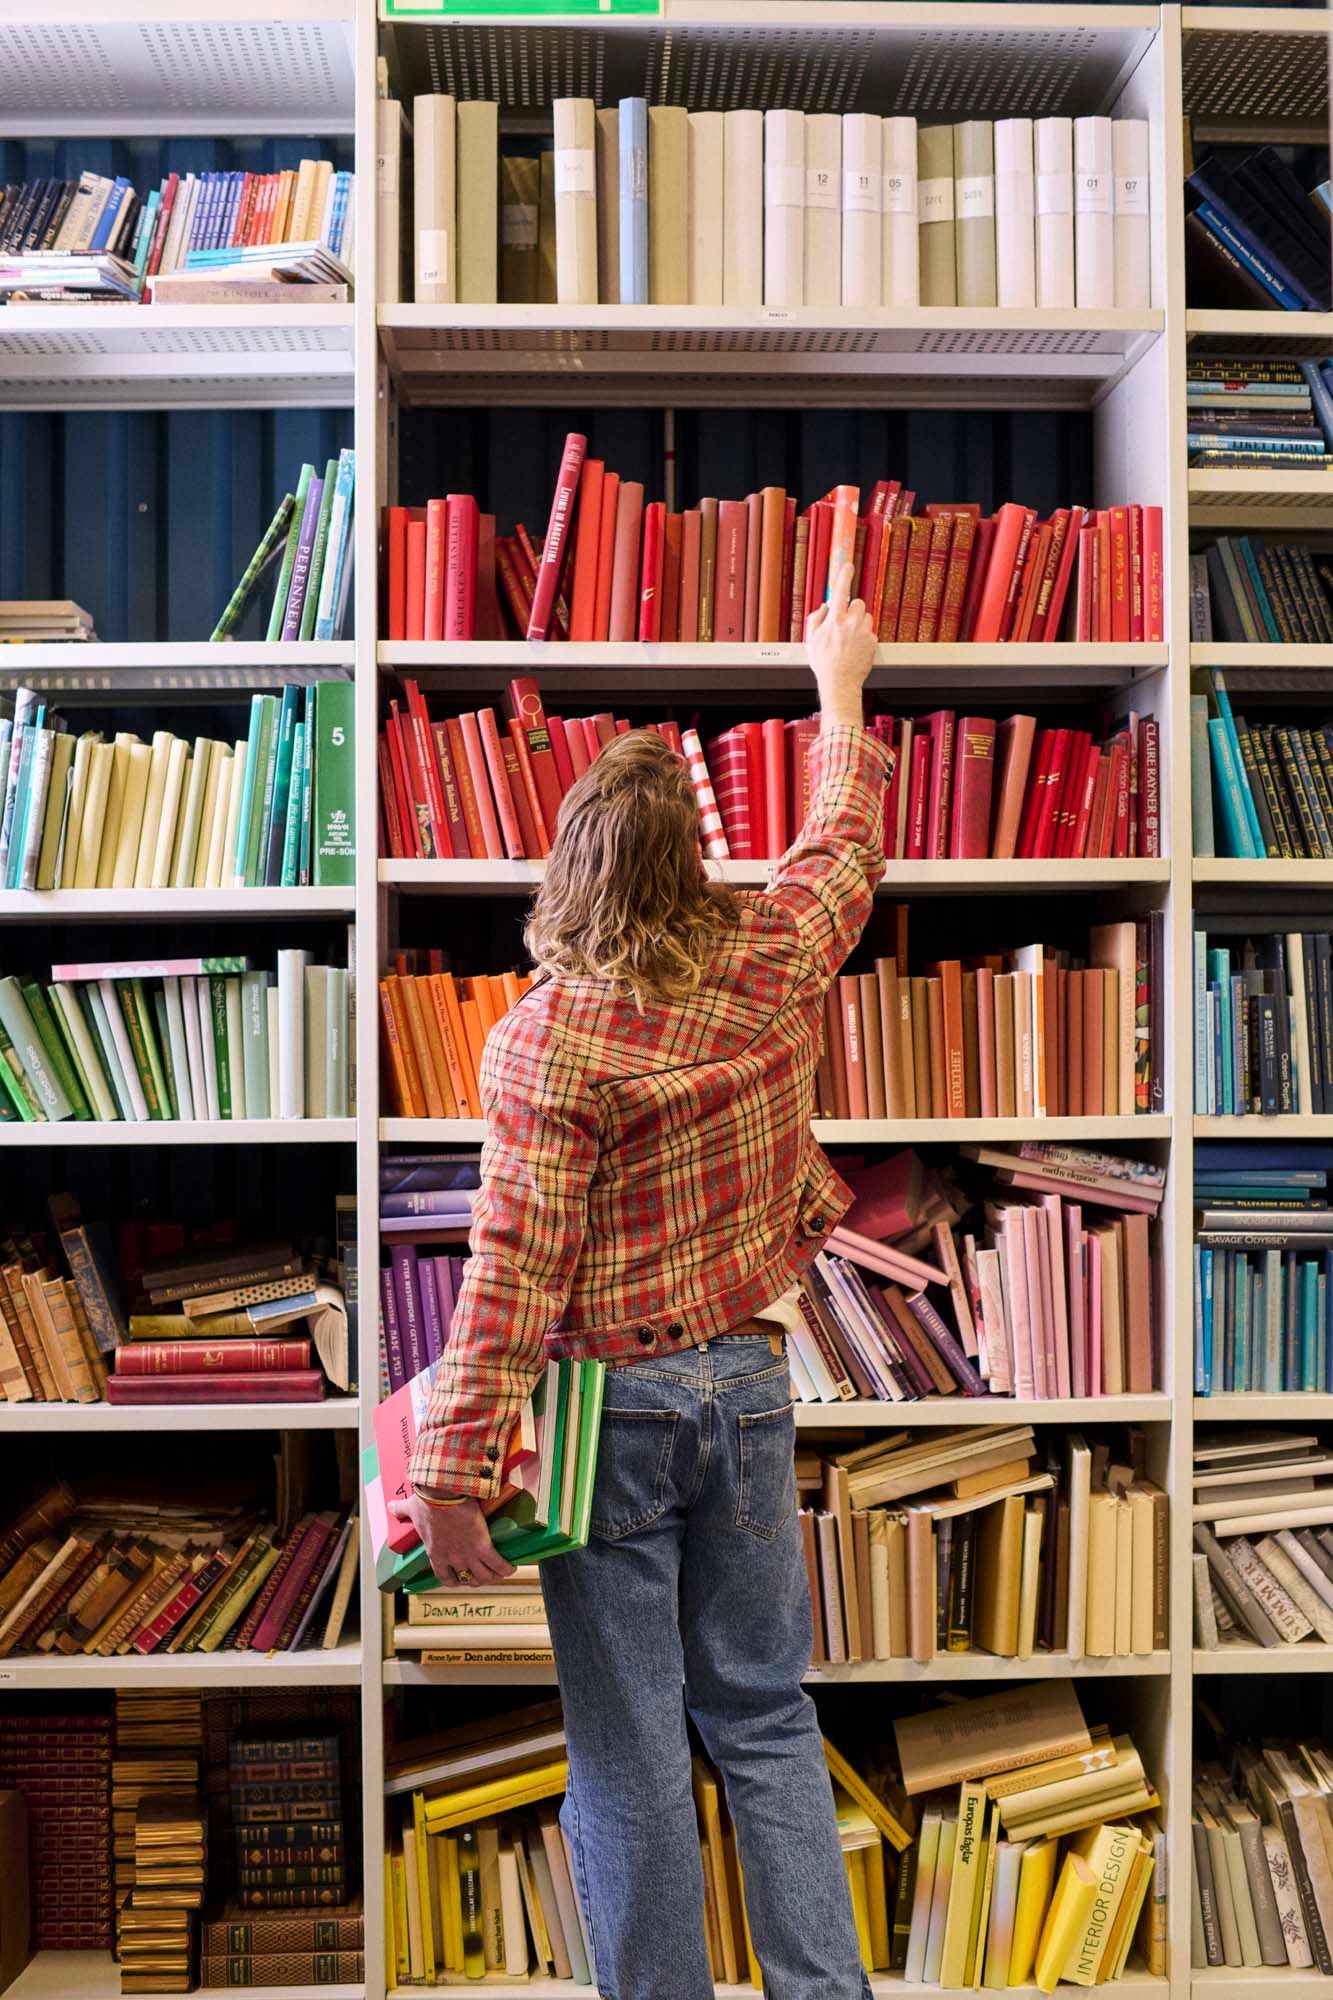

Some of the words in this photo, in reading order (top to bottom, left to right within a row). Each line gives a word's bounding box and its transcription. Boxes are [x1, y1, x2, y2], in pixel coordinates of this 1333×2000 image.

[816, 173, 829, 185] 12
[858, 175, 870, 186] 11
[888, 178, 902, 188] 05
[1086, 178, 1099, 189] 01
[1124, 180, 1138, 191] 07
[557, 487, 570, 511] LIVING
[546, 522, 562, 563] ARGENTINA
[284, 546, 312, 630] PERENNER
[331, 727, 345, 746] 5
[1146, 724, 1157, 766] CLAIRE
[1118, 791, 1127, 817] Guide
[1147, 768, 1157, 813] RAYNER
[952, 1048, 961, 1107] STOLTHET
[1282, 1082, 1290, 1110] Depths
[1041, 1165, 1066, 1178] earthy
[1066, 1171, 1098, 1185] elegance
[1207, 1235, 1243, 1244] SAVAGE
[1245, 1236, 1288, 1244] ODYSSEY
[410, 1328, 419, 1357] GETTING
[422, 1602, 459, 1618] DONNA
[459, 1604, 495, 1617] TARTT
[1242, 1561, 1304, 1638] SUMMER
[464, 1652, 483, 1662] Den
[484, 1652, 513, 1662] andre
[514, 1652, 552, 1662] brodern
[962, 1797, 978, 1836] Europas
[1075, 1897, 1111, 1977] INTERIOR
[1098, 1830, 1130, 1895] DESIGN
[1201, 1888, 1212, 1920] Vision
[1205, 1922, 1218, 1959] Crystal
